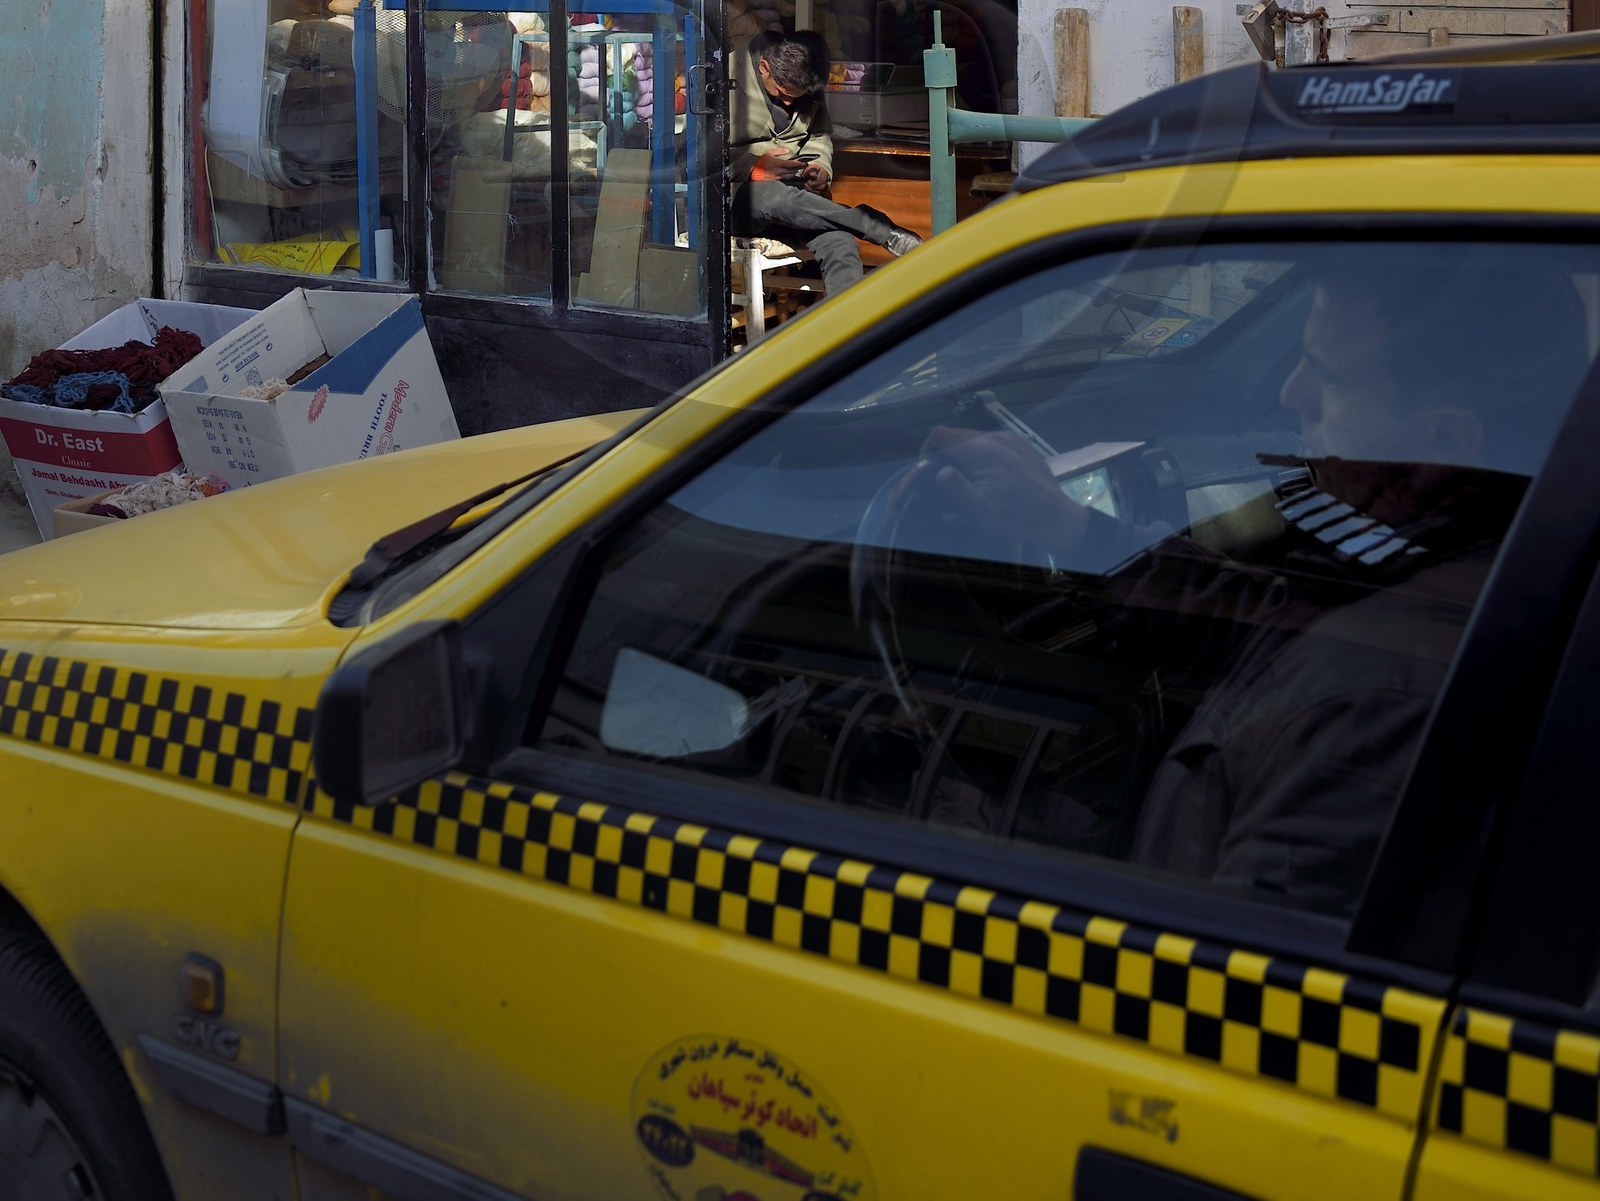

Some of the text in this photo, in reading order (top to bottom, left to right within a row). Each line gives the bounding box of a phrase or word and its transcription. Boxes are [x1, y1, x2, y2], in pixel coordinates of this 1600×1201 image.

[1297, 72, 1453, 112] HamSafar
[370, 392, 388, 431] TOOTH
[35, 428, 104, 453] Dr. East
[61, 454, 92, 468] Classic
[31, 468, 59, 481] Jamal
[60, 473, 107, 489] Behdasht
